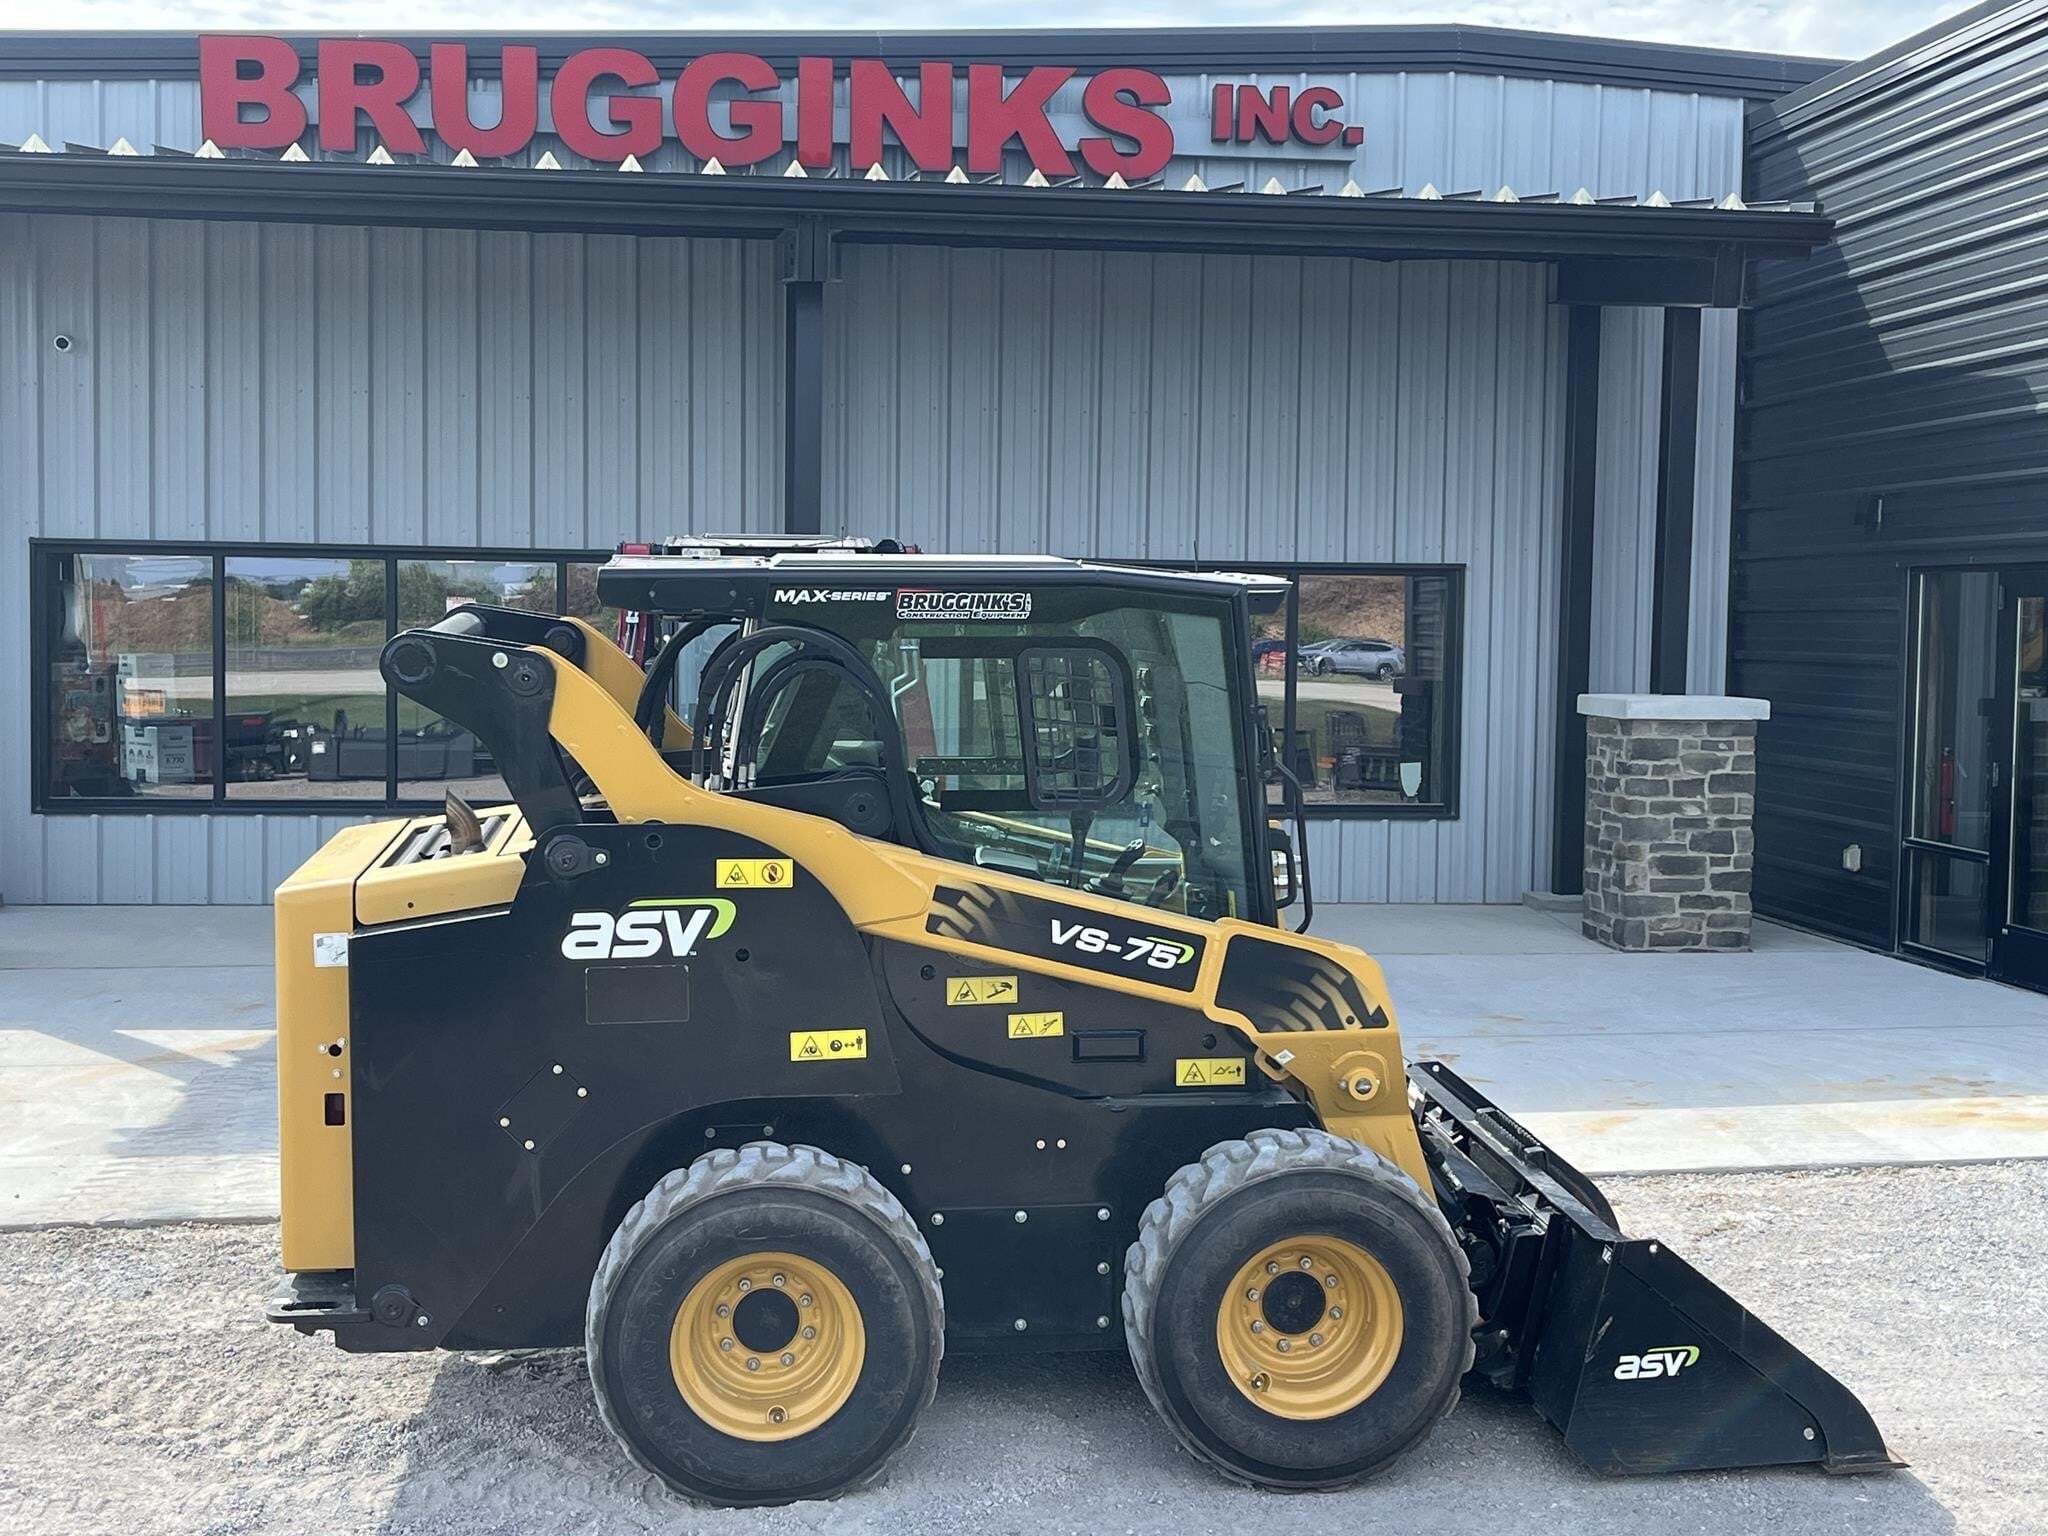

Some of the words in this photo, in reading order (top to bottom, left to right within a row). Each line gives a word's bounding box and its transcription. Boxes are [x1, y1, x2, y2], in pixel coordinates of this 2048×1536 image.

[198, 34, 1175, 181] BRUGGINKS
[1211, 83, 1364, 146] INC.
[774, 589, 890, 605] MAX-SERIES
[897, 592, 1025, 611] BRUGGINK'S
[1051, 919, 1182, 970] VS-75
